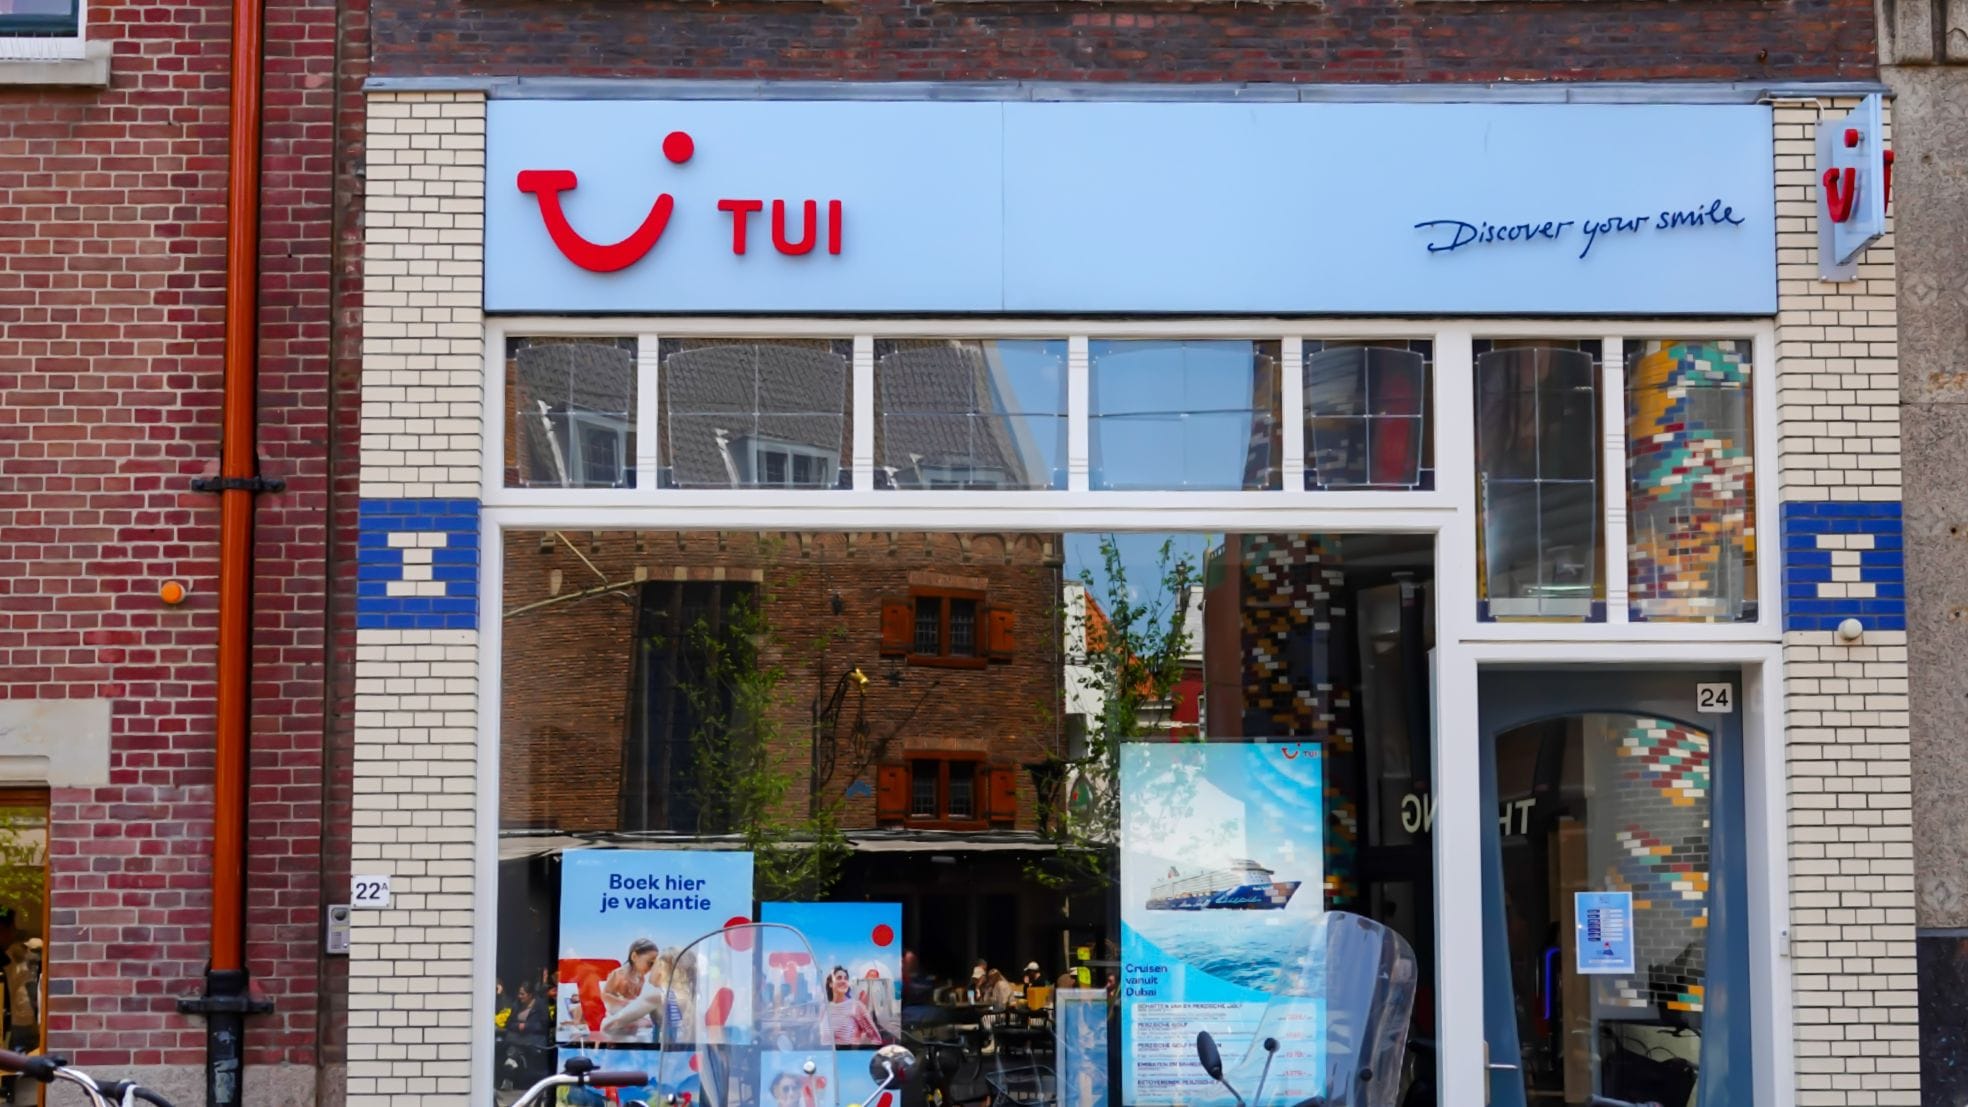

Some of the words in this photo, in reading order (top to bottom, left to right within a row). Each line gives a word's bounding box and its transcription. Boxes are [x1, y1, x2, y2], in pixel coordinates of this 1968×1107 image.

[717, 199, 842, 256] TUI
[1414, 219, 1575, 252] Discover
[1583, 216, 1650, 259] your
[1656, 199, 1745, 231] smile
[1700, 688, 1729, 708] 24
[609, 873, 660, 890] Boek
[665, 874, 706, 891] hier
[600, 893, 619, 913] je
[625, 893, 712, 911] vakantie
[1126, 963, 1168, 973] Cruisen
[1126, 975, 1158, 985] vanuit
[1126, 987, 1157, 997] Dubai
